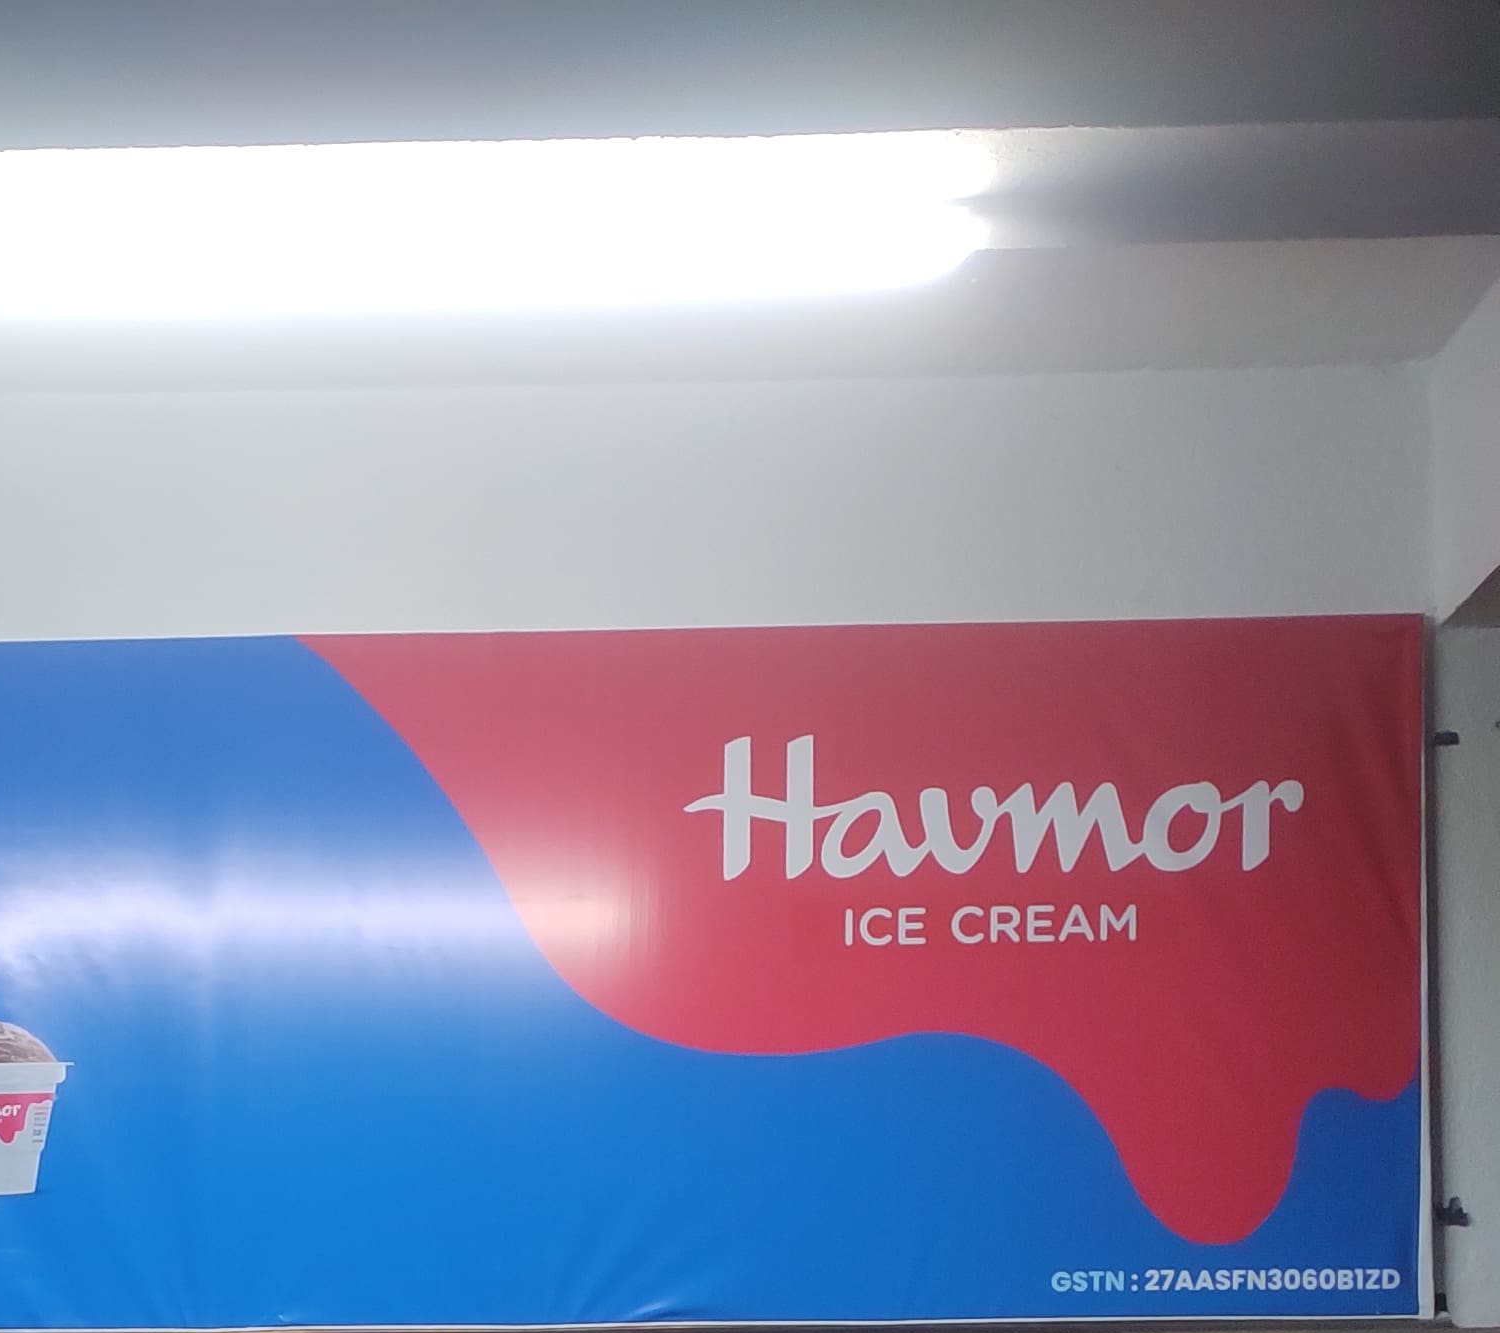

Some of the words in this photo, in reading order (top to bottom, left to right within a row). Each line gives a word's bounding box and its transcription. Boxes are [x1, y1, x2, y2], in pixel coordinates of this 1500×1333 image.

[683, 734, 1305, 881] Havmor
[843, 907, 927, 947] ICE
[950, 903, 1140, 944] CREAM
